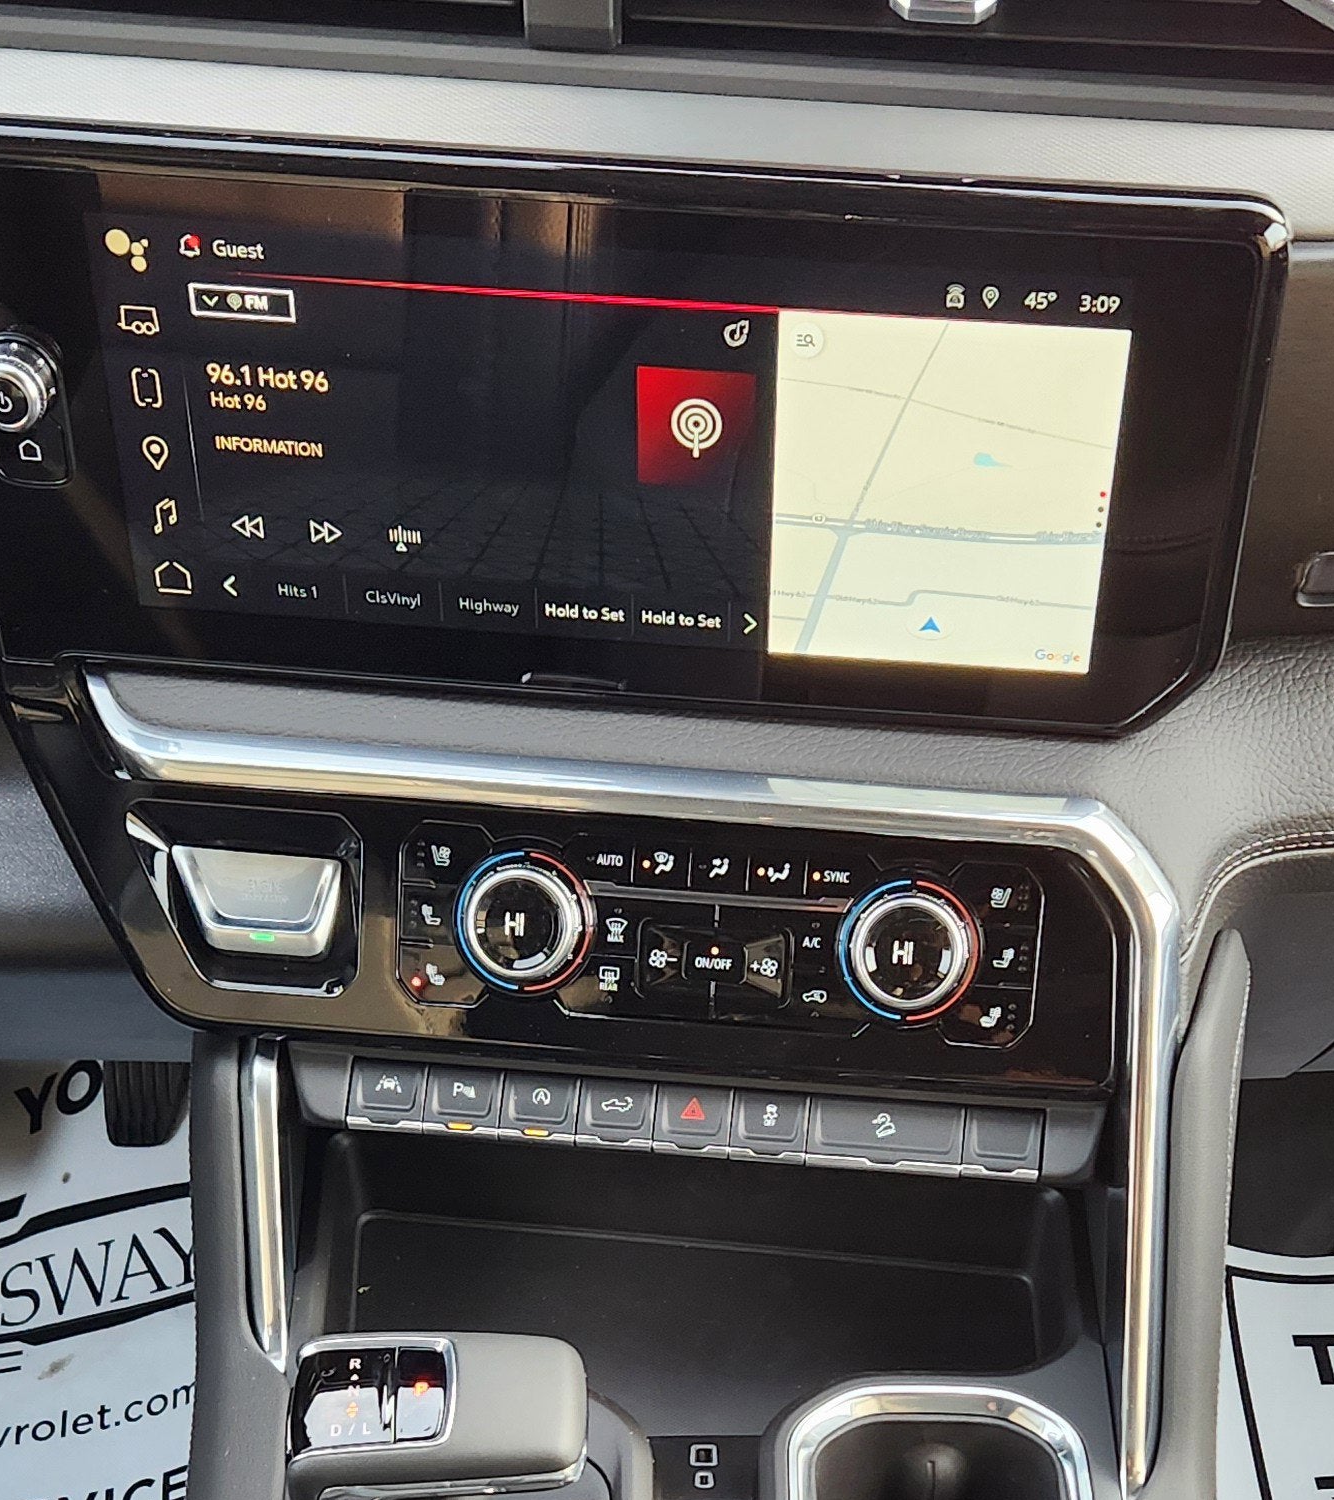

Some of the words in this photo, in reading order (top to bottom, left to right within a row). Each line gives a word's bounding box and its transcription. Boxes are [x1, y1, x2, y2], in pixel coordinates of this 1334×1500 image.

[212, 239, 265, 260] Guest
[244, 294, 269, 312] FM
[1078, 294, 1121, 315] 3:09
[205, 362, 252, 386] 96.1
[257, 366, 298, 389] Hot
[299, 369, 330, 393] 96
[210, 391, 242, 410] Hot
[243, 393, 267, 411] 96
[214, 435, 324, 458] INFORMATION
[277, 583, 307, 598] Hits
[458, 597, 519, 617] Highway
[544, 603, 579, 619] Hold
[582, 606, 598, 620] to
[601, 607, 626, 623] Set
[641, 610, 676, 626] Hold
[678, 613, 695, 627] to
[697, 614, 722, 629] Set
[1035, 648, 1081, 665] Google
[596, 852, 624, 868] AUTO
[823, 869, 851, 885] SYNC
[503, 911, 526, 937] HI
[801, 935, 822, 950] A/C
[891, 940, 915, 966] HI
[694, 956, 734, 972] ON/OFF
[14, 1060, 103, 1135] YO
[349, 1357, 362, 1370] R
[413, 1381, 430, 1398] P
